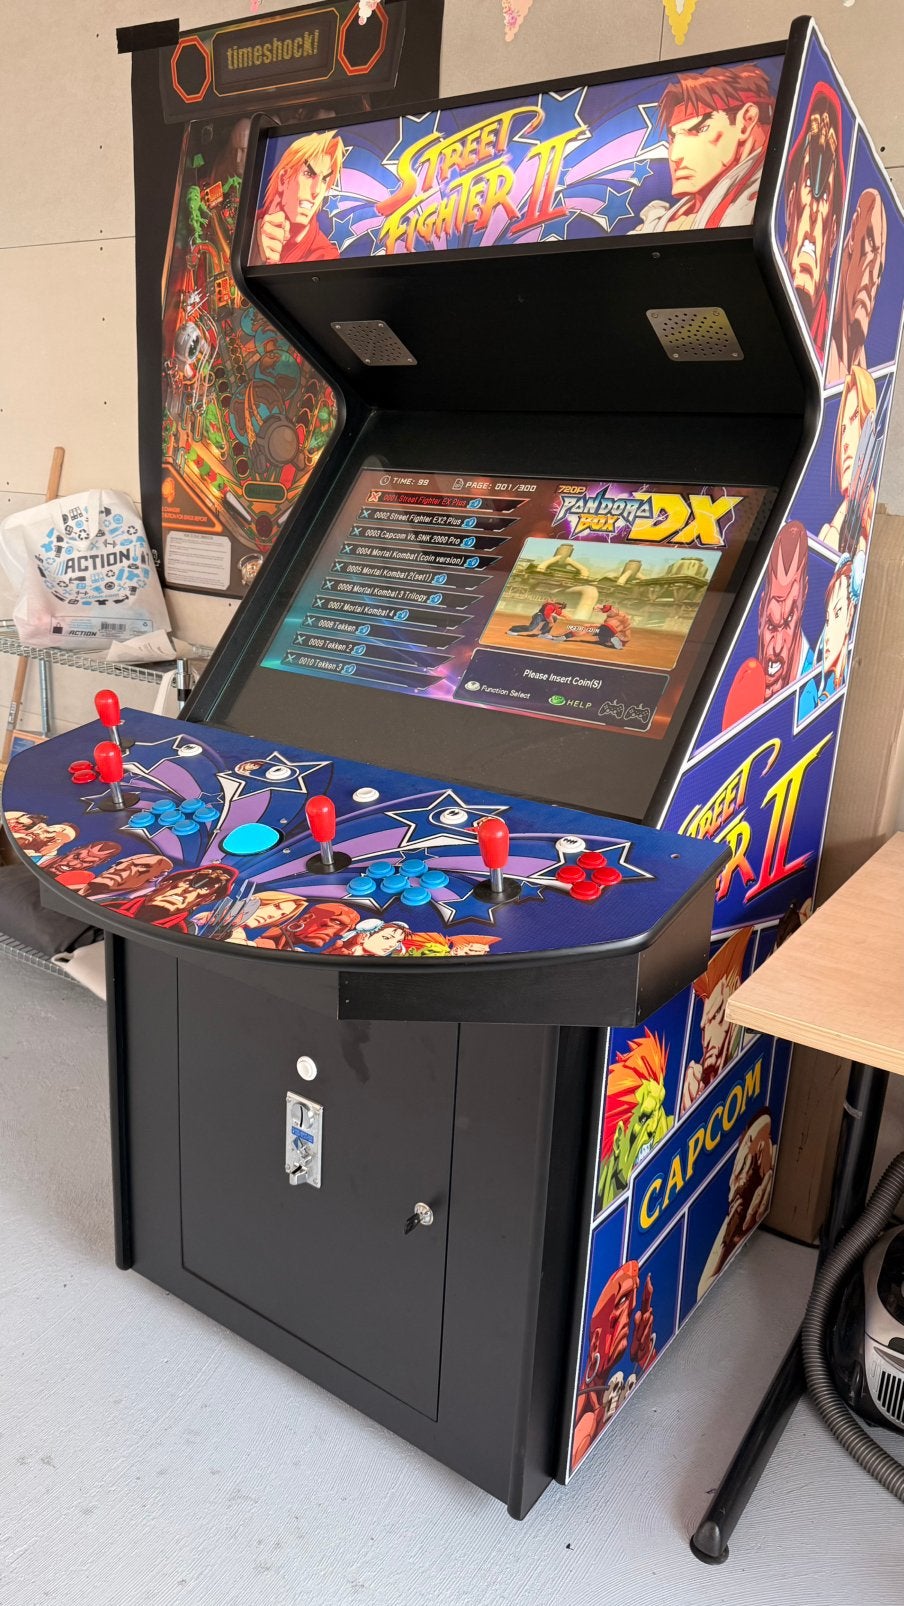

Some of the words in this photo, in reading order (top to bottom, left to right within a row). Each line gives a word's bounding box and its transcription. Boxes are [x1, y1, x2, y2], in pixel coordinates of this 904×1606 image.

[226, 29, 320, 70] timeshock!
[375, 106, 545, 216] STREET
[378, 154, 521, 255] FIGHTER
[509, 124, 590, 236] II
[393, 477, 415, 485] TIME:
[465, 481, 492, 490] PAGE:
[495, 483, 537, 492] 001/300
[558, 485, 586, 493] 720P
[399, 495, 418, 503] Street
[420, 496, 440, 505] Fighter
[451, 499, 467, 507] Plus
[374, 511, 390, 519] 0002
[390, 512, 409, 520] Street
[409, 514, 432, 523] Fighter
[433, 516, 446, 524] EX2
[446, 517, 461, 526] Plus
[553, 487, 653, 525] PANDORA
[627, 492, 743, 546] DX
[573, 514, 620, 536] BOX
[365, 529, 381, 537] 0003
[381, 530, 406, 540] Capcom
[432, 535, 449, 544] 2000
[448, 537, 460, 545] Pro
[64, 548, 131, 575] ACTION
[356, 547, 371, 555] 0004
[372, 548, 391, 557] Mortal
[393, 550, 417, 560] Kombat
[417, 552, 435, 562] (coin
[436, 556, 464, 565] version)
[346, 564, 361, 573] 0005
[362, 566, 382, 575] Mortal
[383, 568, 407, 578] Kombat
[353, 585, 372, 594] Mortal
[373, 587, 398, 597] Kombat
[404, 591, 428, 602] Trilogy
[328, 601, 344, 609] 0007
[343, 603, 363, 612] Mortal
[364, 605, 388, 616] Kombat
[334, 622, 356, 632] Tekken
[308, 638, 324, 647] 0009
[324, 641, 346, 651] Tekken
[298, 657, 314, 665] 0010
[314, 660, 337, 670] Tekken
[523, 669, 548, 680] Please
[549, 673, 571, 684] Insert
[572, 677, 603, 689] Coin(S)
[481, 685, 509, 696] Function
[509, 689, 531, 699] Select
[567, 699, 592, 709] HELP
[640, 1058, 762, 1229] CAPCOM
